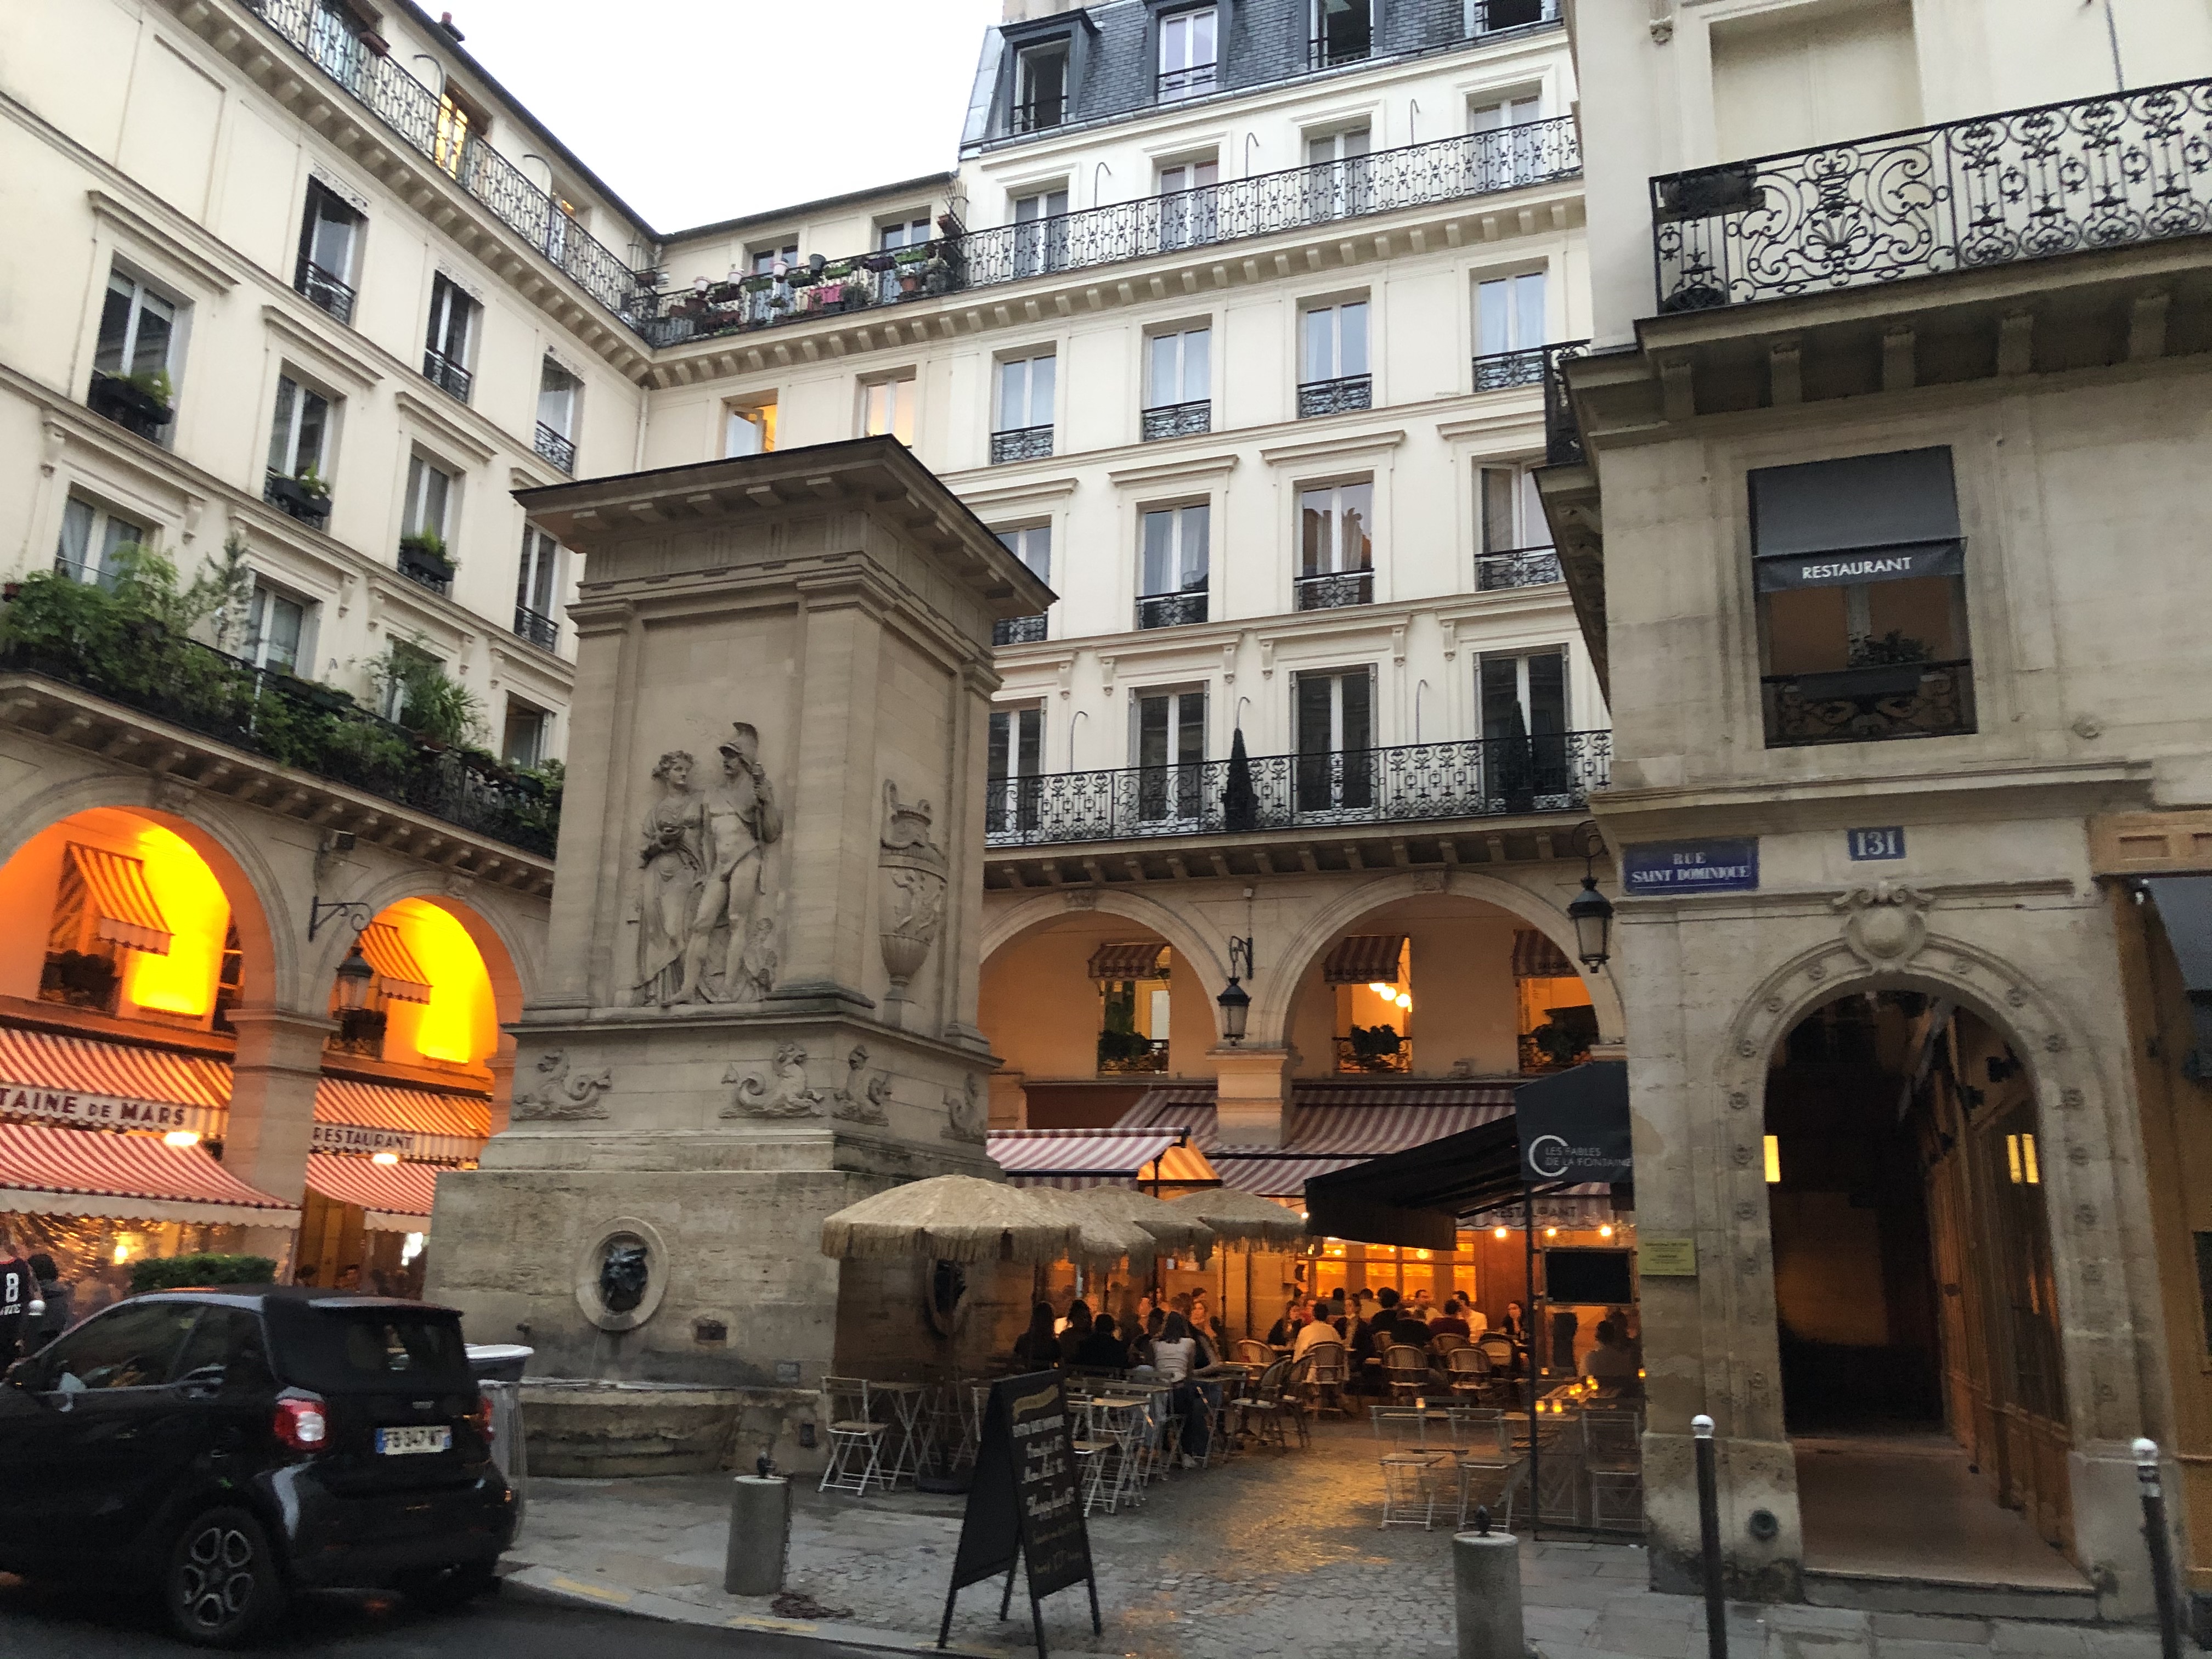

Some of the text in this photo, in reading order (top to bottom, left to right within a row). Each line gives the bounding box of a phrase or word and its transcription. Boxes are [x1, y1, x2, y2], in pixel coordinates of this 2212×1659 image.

[1802, 557, 1912, 579] RESTAURANT
[1857, 831, 1897, 856] 131
[1673, 852, 1706, 865] RUE
[1632, 865, 1752, 883] SAINT DOMINIQUE
[0, 1088, 185, 1126] TAINE DE MARS
[313, 1127, 413, 1149] RESTAURANT
[1545, 1147, 1601, 1156] LES FABLES
[1545, 1157, 1633, 1167] DE LA FONTAINE
